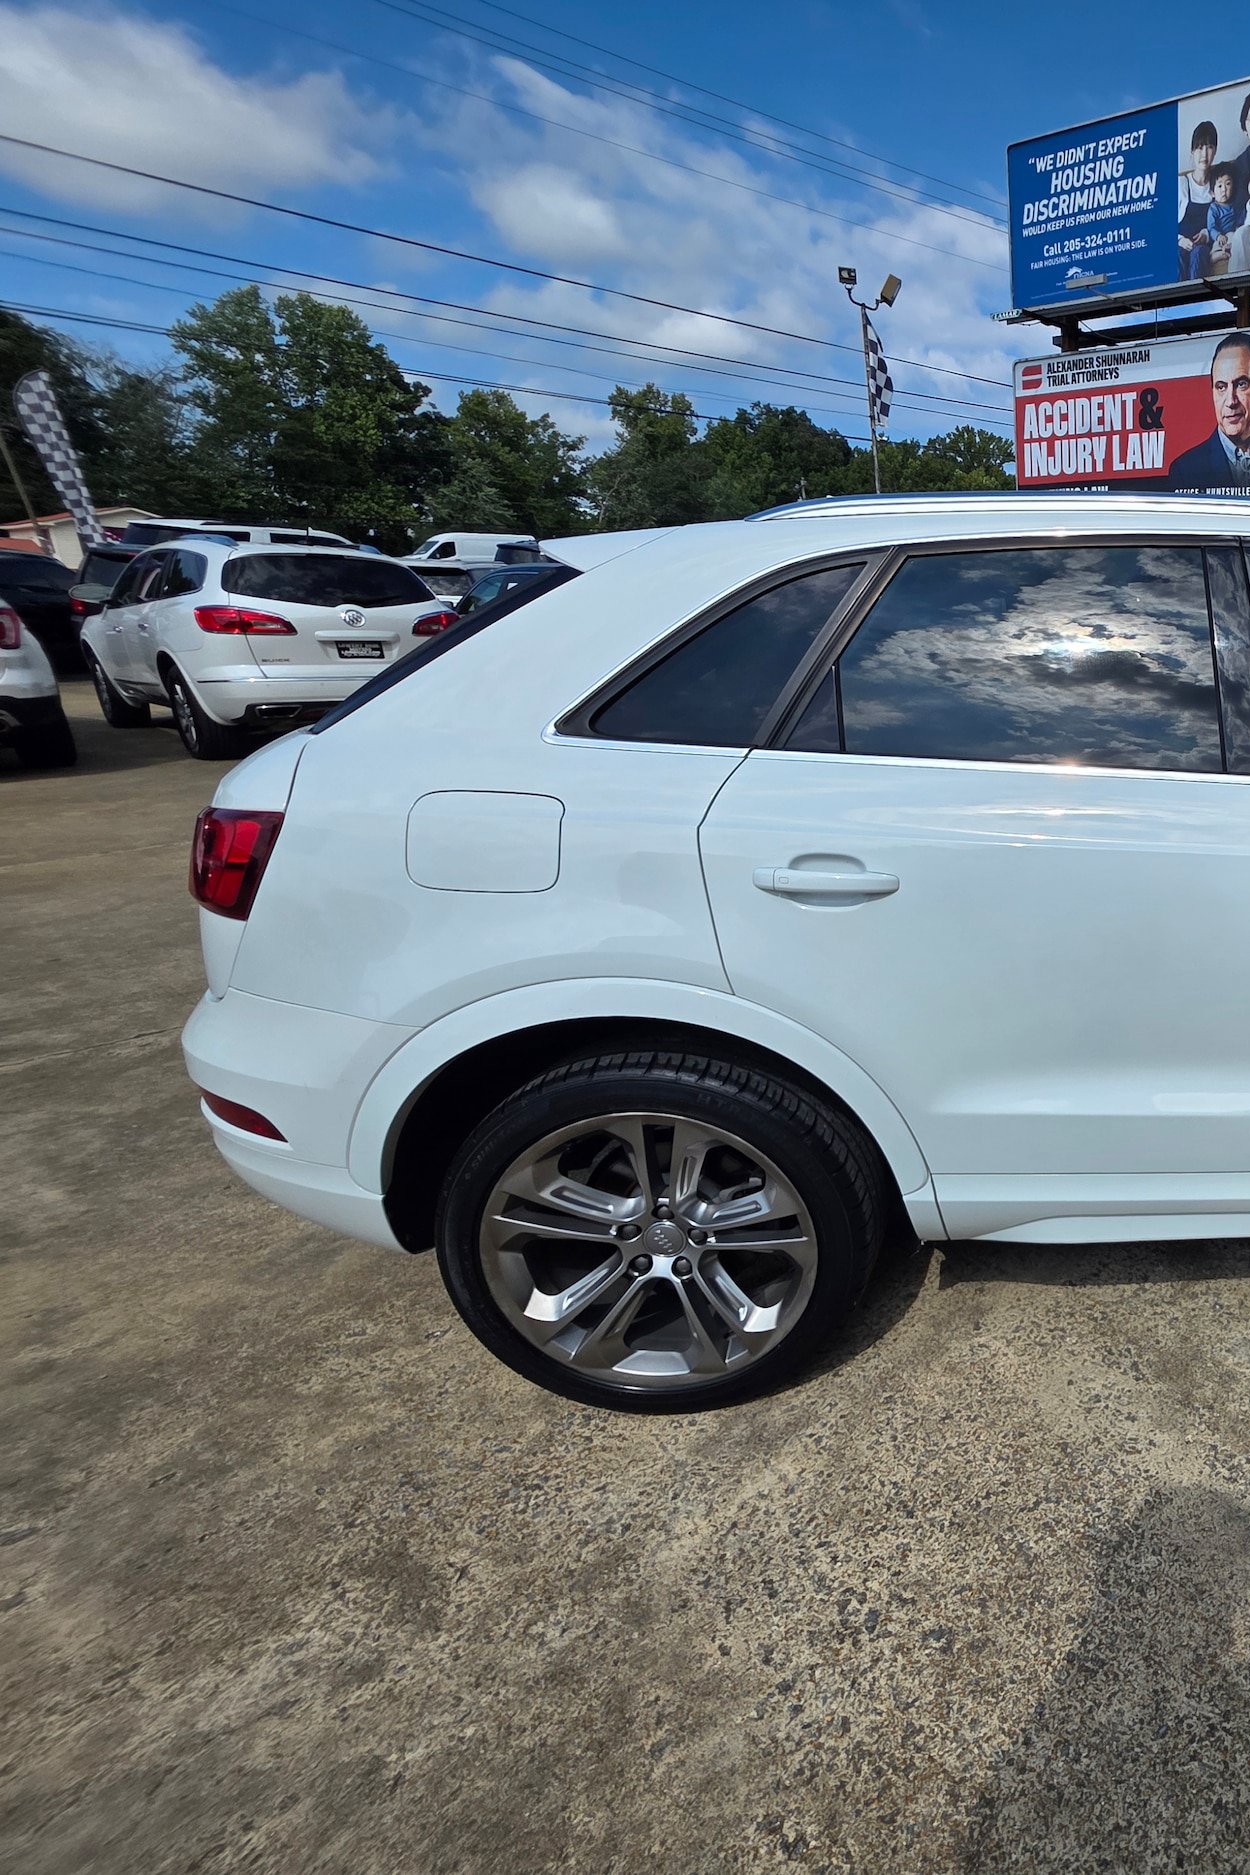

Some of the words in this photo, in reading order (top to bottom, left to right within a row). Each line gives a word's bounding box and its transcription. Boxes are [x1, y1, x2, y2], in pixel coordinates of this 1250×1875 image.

[1056, 142, 1096, 168] DIDN’T
[1098, 129, 1146, 157] EXPECT
[1050, 155, 1124, 194] HOUSING
[1023, 172, 1157, 225] DISCRIMINATION
[1022, 224, 1046, 238] WOULD
[1047, 219, 1064, 232] KEEP
[1065, 216, 1075, 227] US
[1076, 211, 1096, 225] FROM
[1096, 208, 1111, 220] OUR
[1112, 204, 1130, 217] NEW
[1030, 261, 1044, 270] FAIR
[1071, 252, 1083, 261] THE
[1083, 249, 1097, 260] LAW
[1097, 248, 1104, 256] IS
[1104, 245, 1114, 255] ON
[1114, 242, 1131, 253] YOUR
[1131, 239, 1148, 249] SIDE.
[1043, 242, 1061, 257] Call
[1063, 227, 1131, 254] 205-324-0111
[1046, 357, 1095, 375] ALEXANDER
[1095, 349, 1151, 369] SHUNNARAH
[1046, 374, 1070, 388] TRIAL
[1071, 367, 1120, 385] ATTORNEYS
[1023, 391, 1137, 440] ACCIDENT
[1138, 387, 1165, 431] &
[1023, 435, 1107, 478] INJURY
[1112, 430, 1166, 472] LAW
